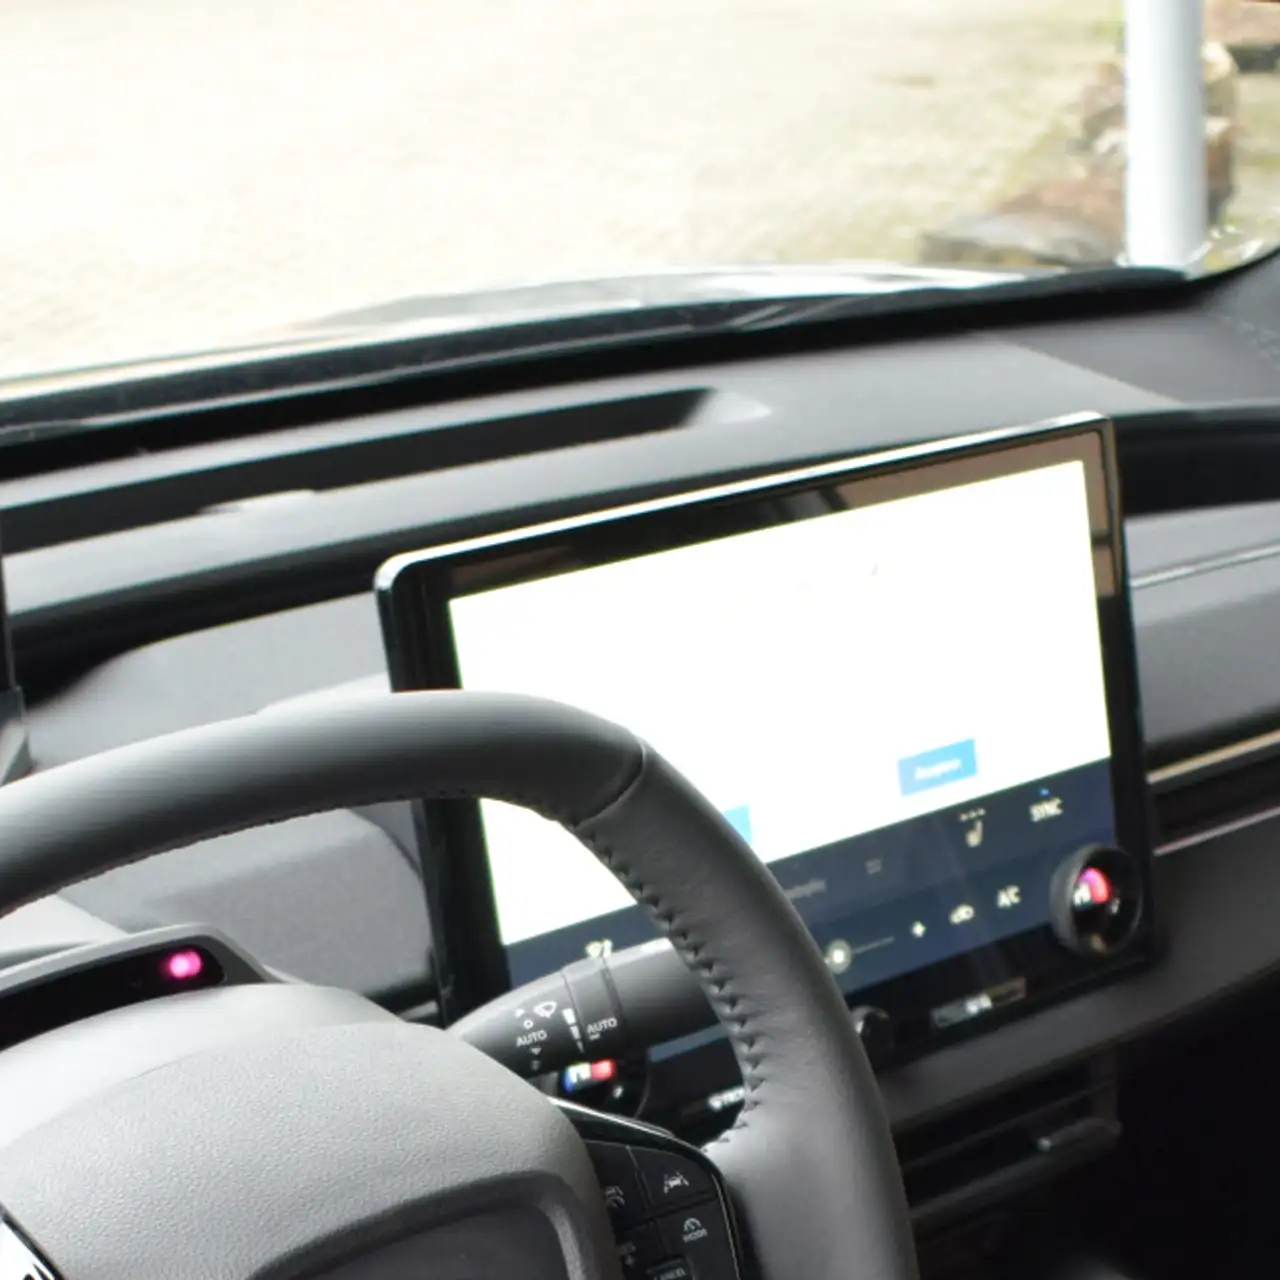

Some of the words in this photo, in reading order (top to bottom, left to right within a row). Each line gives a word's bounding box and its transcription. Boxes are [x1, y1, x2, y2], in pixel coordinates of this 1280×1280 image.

[586, 1017, 618, 1034] AUTO
[516, 1029, 548, 1047] AUTO
[682, 1227, 709, 1244] MODE
